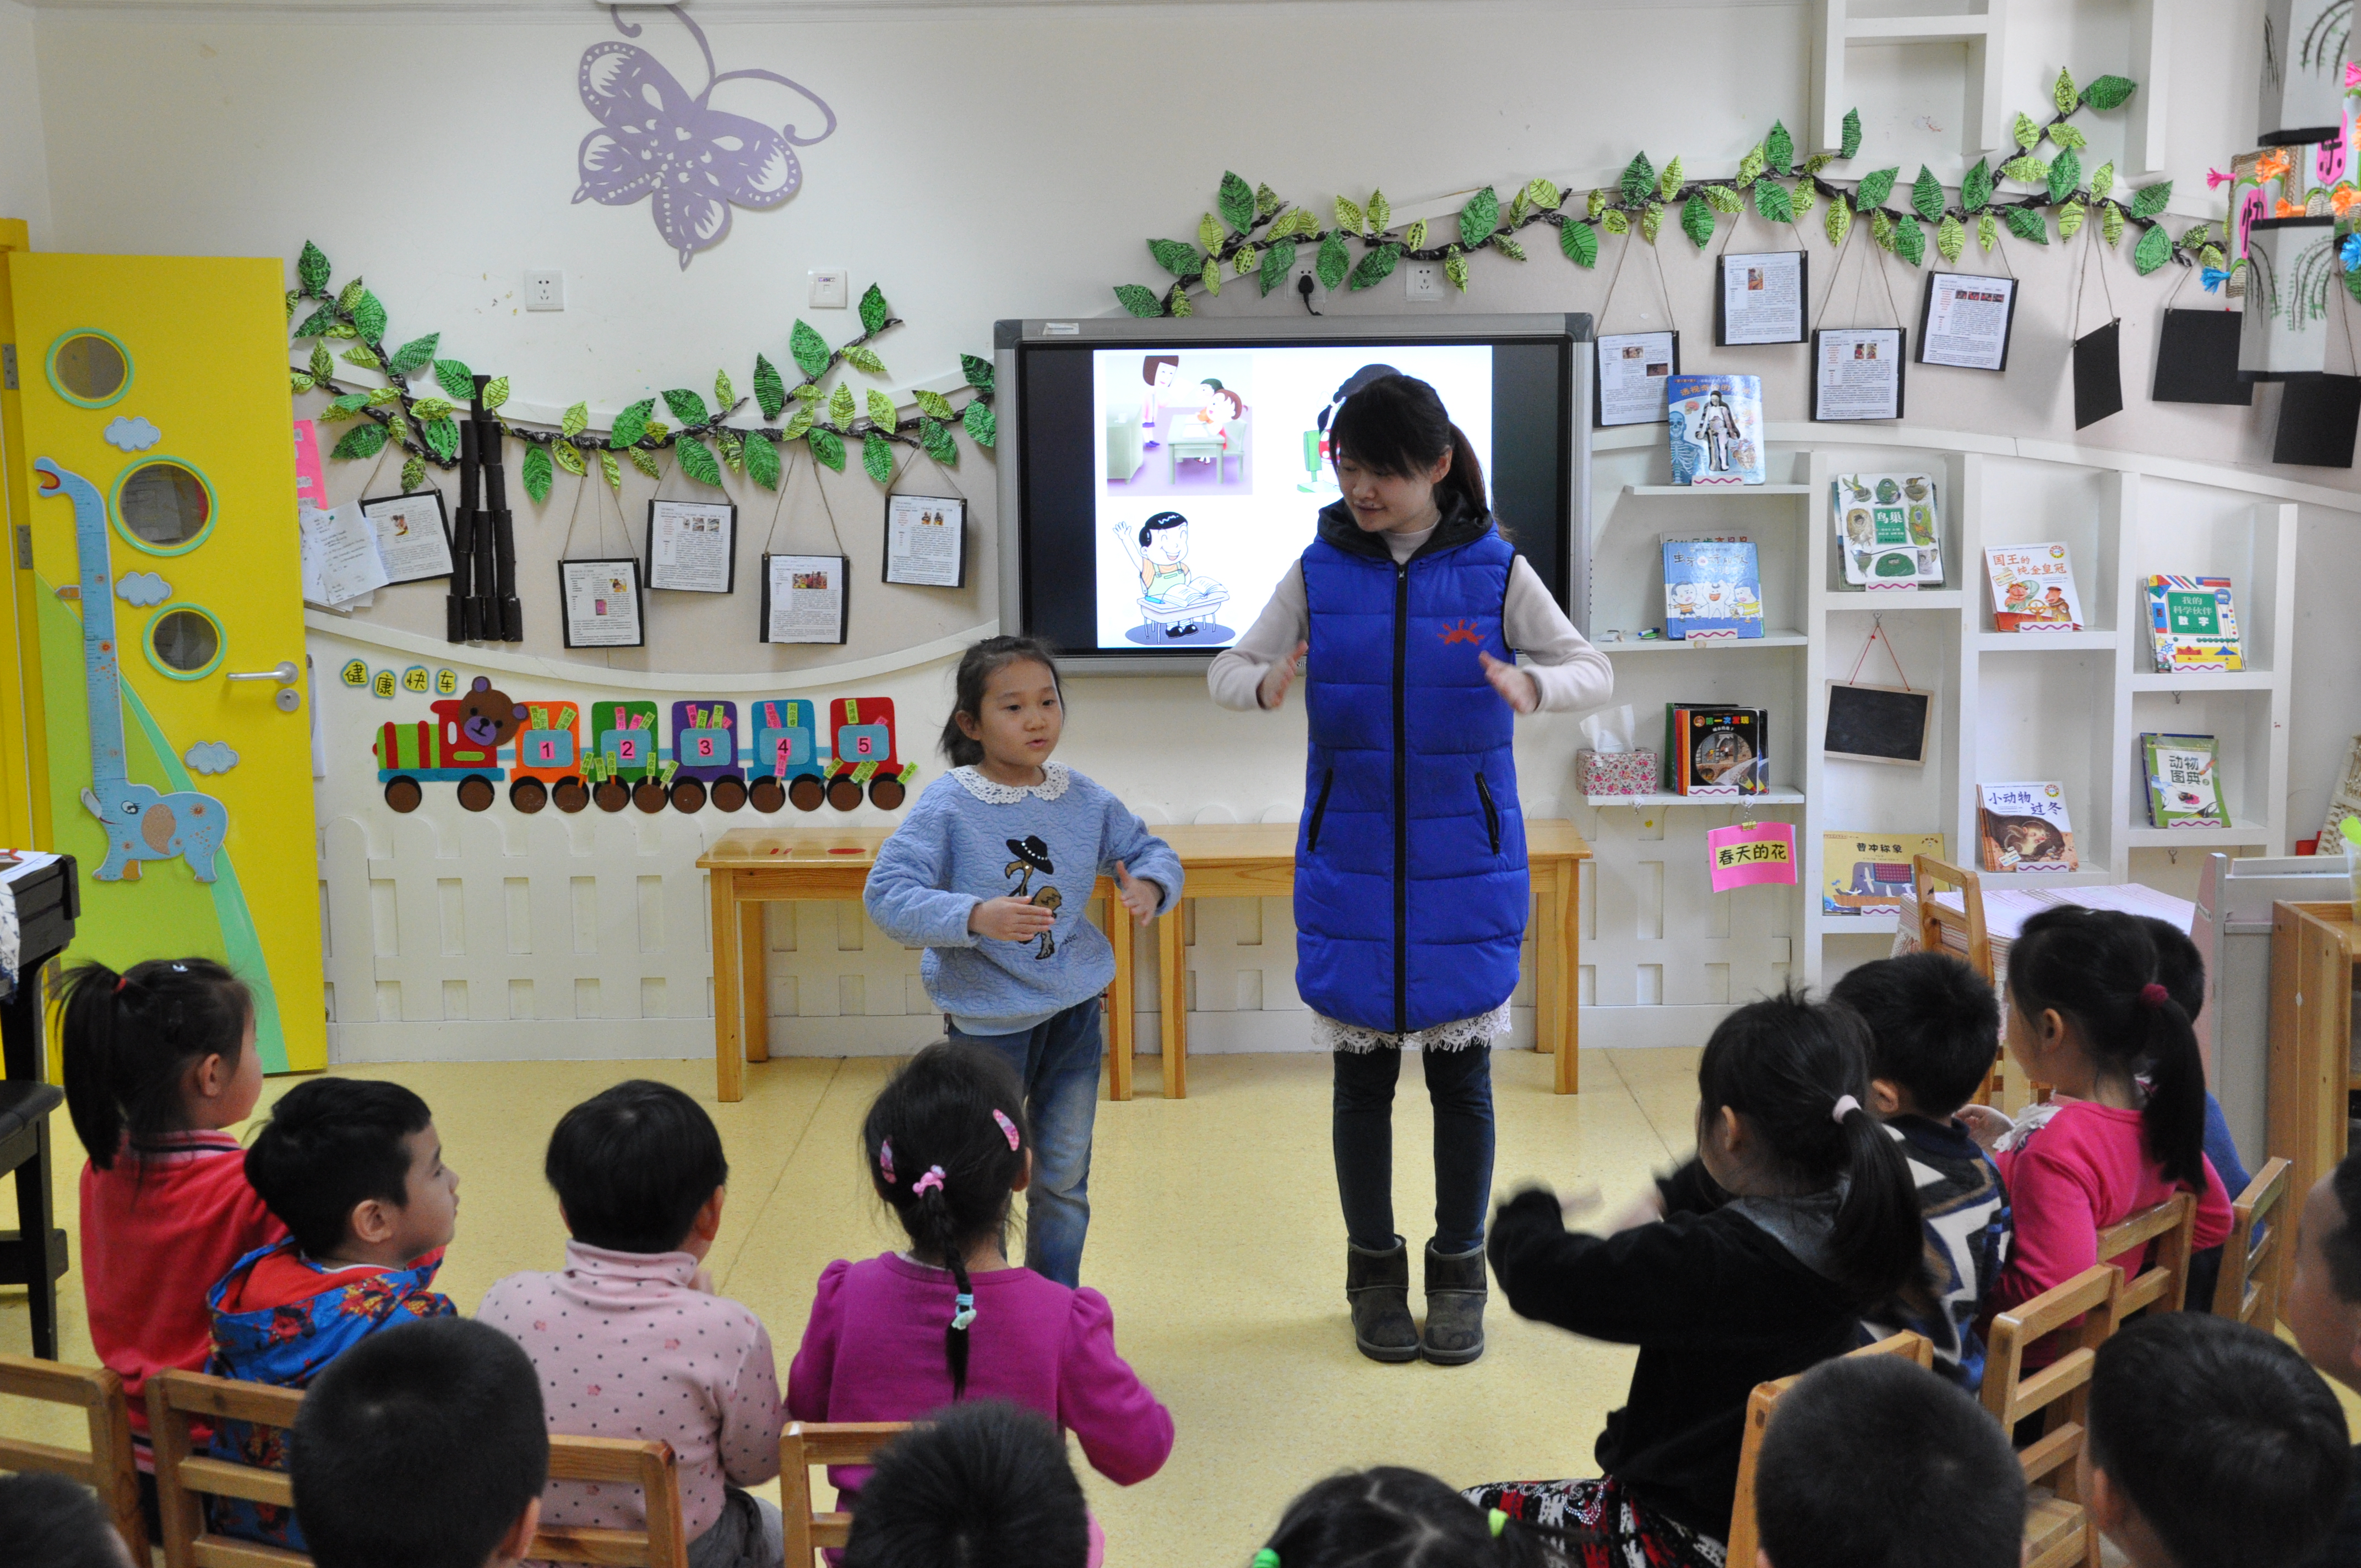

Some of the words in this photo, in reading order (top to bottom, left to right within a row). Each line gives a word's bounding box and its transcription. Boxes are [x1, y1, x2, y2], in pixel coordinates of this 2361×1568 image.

[1877, 511, 1903, 524] 鸟巢
[1993, 554, 2030, 566] 国王的
[2017, 563, 2066, 575] 纯金皇冠
[2182, 596, 2202, 605] 我的
[2173, 606, 2212, 615] 科学伙伴
[2178, 616, 2209, 627] 数字
[345, 663, 454, 695] 健康快车
[1706, 716, 1749, 725] 第一次发现
[542, 742, 550, 758] 1
[622, 741, 633, 756] 2
[700, 739, 711, 755] 3
[777, 738, 789, 754] 4
[859, 738, 869, 753] 5
[2169, 755, 2199, 770] 动物
[2170, 770, 2201, 785] 图典
[1989, 791, 2031, 805] 小动物
[2031, 802, 2063, 815] 过冬
[1719, 843, 1787, 865] 春天的花
[1856, 842, 1903, 853] 曹冲称象
